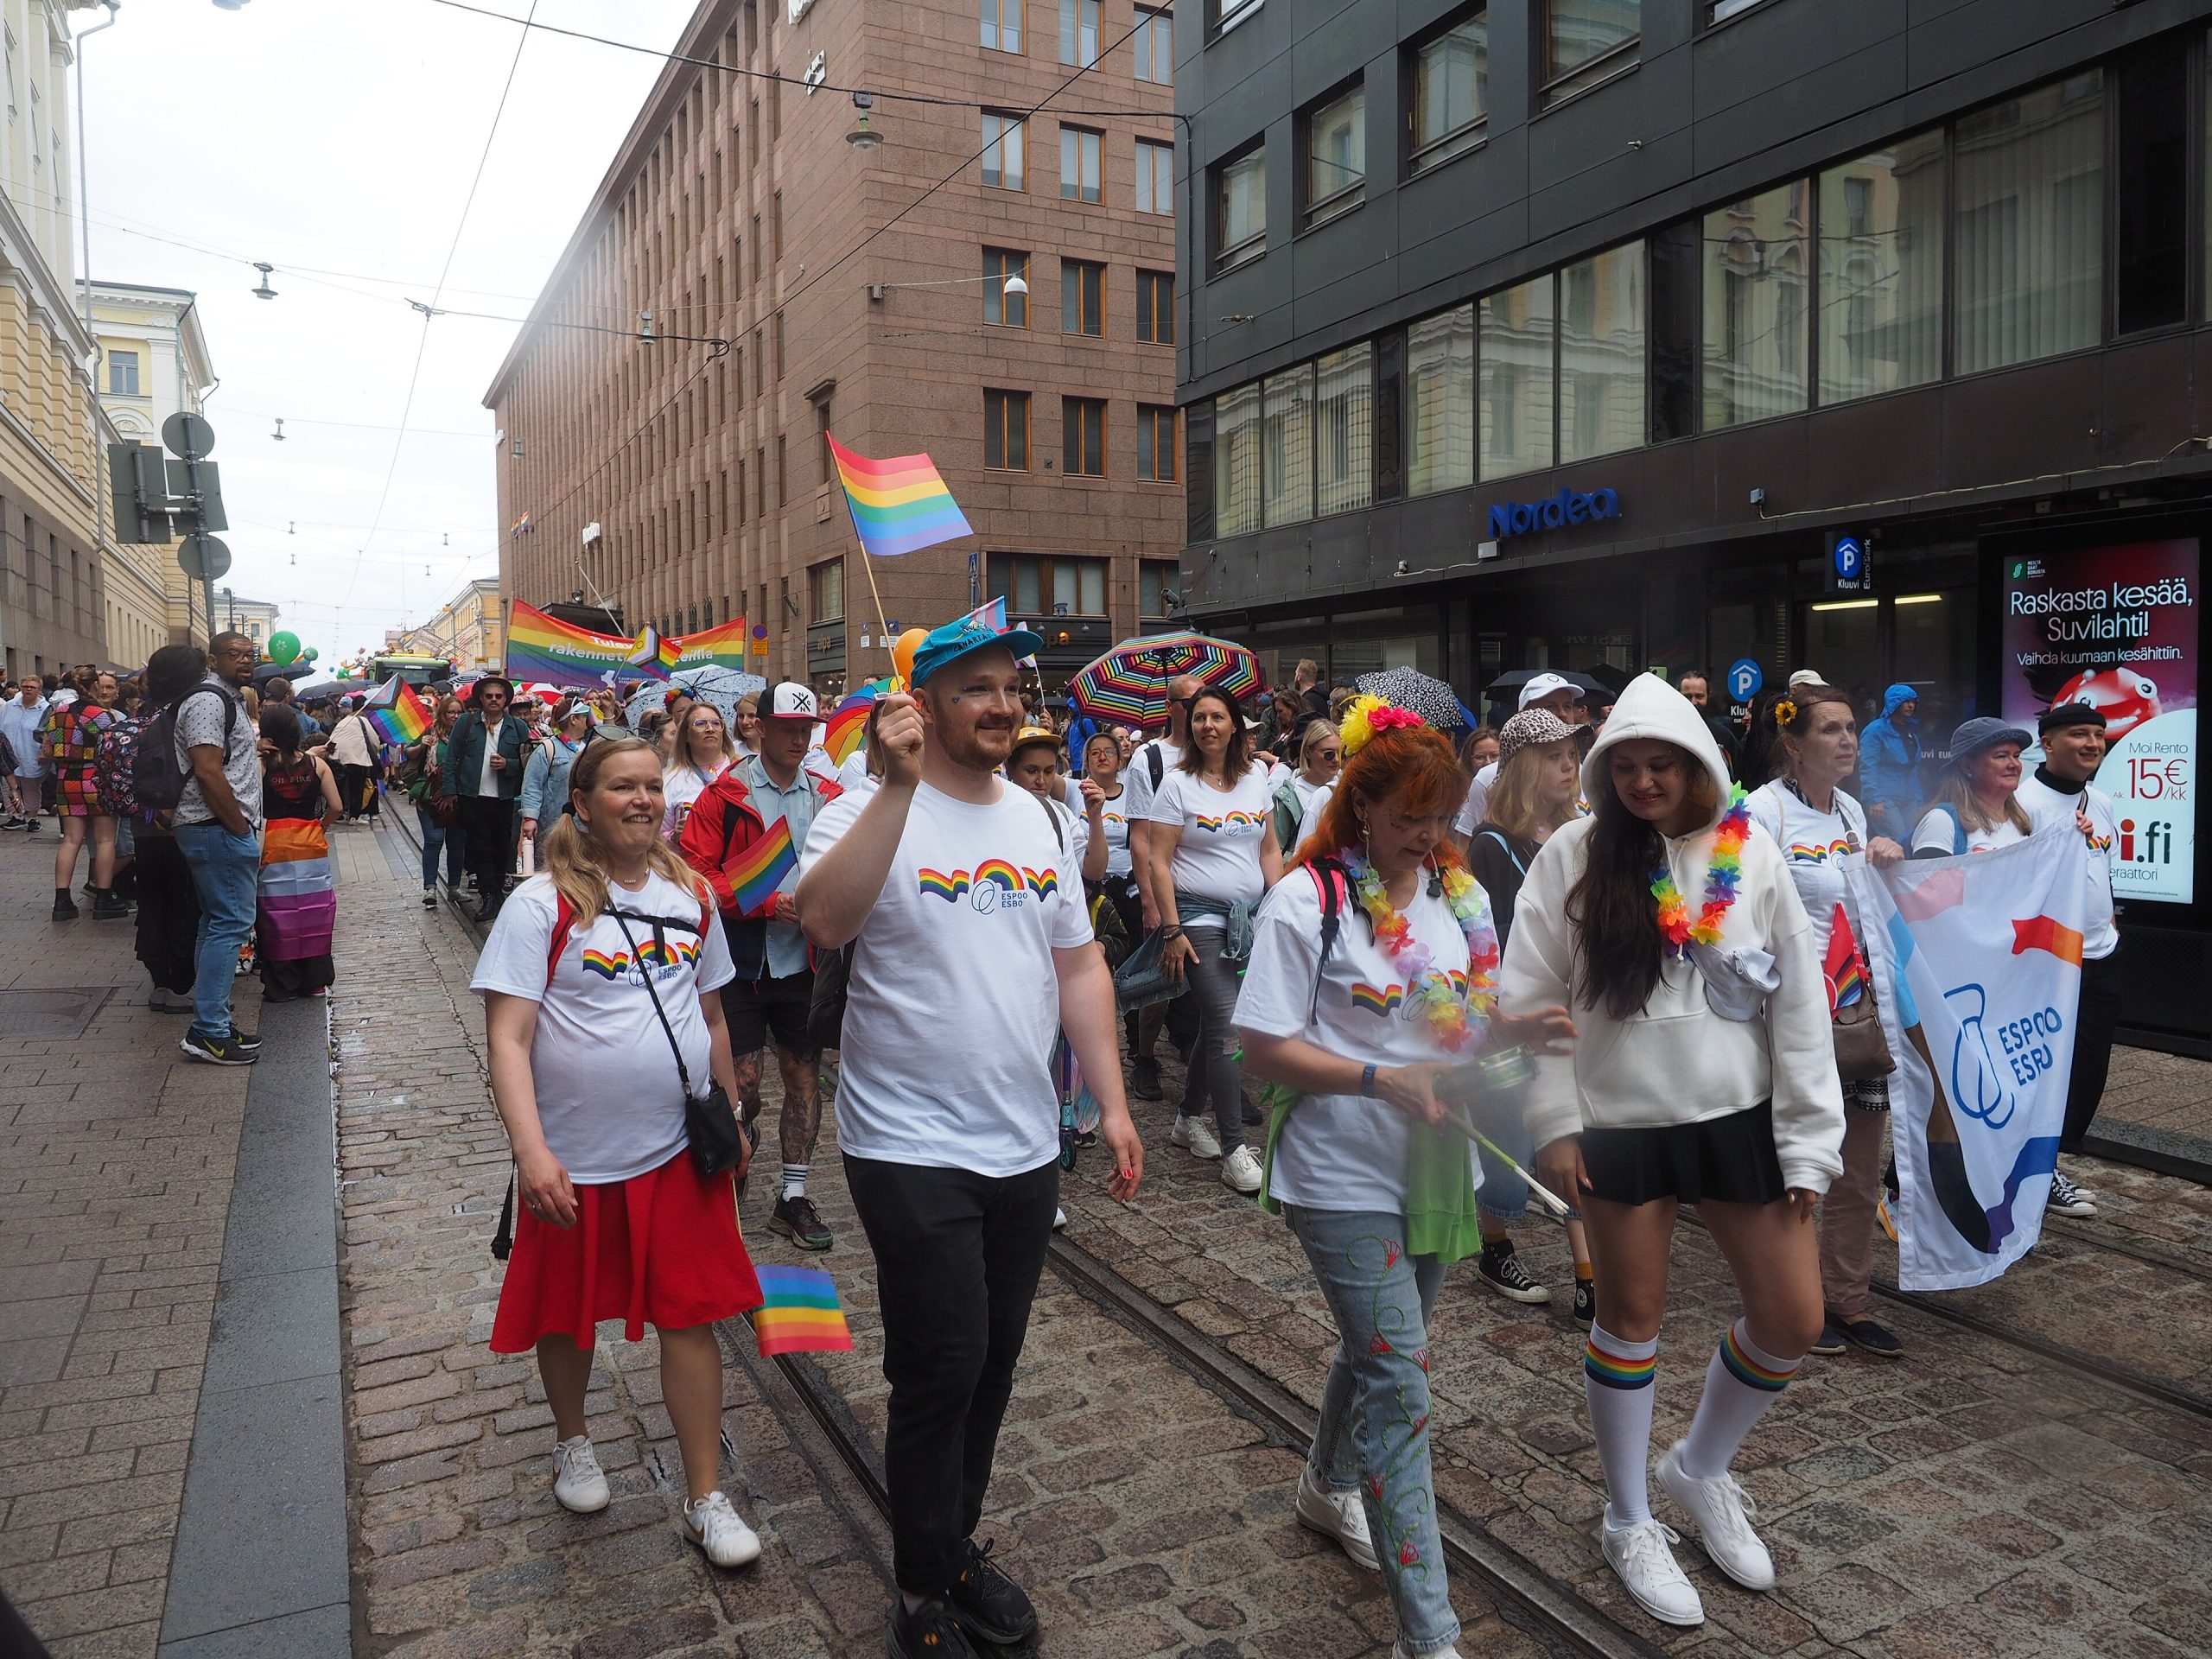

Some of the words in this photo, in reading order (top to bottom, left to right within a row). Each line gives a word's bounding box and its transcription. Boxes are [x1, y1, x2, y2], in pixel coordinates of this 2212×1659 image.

[1488, 487, 1618, 538] Nordea
[1837, 578, 1860, 589] Kluuvi
[2011, 588, 2107, 615] Raskasta
[2113, 577, 2193, 608] kesää,
[2047, 610, 2150, 642] Suvilahti!
[589, 635, 634, 649] Tulev
[549, 642, 629, 662] rakennet
[2017, 652, 2058, 665] Vaihda
[2061, 650, 2116, 664] kuumaan
[2118, 645, 2183, 662] kesähittiin.
[2129, 742, 2152, 753] Moi
[2155, 743, 2189, 753] Rento
[2113, 818, 2171, 864] i.fi
[2109, 868, 2158, 881] eraattori
[1001, 892, 1028, 900] ESPOO
[1001, 899, 1023, 908] ESBO
[658, 964, 682, 976] ESPOO
[658, 971, 677, 981] ESBO
[1998, 1007, 2063, 1055] ESPOO
